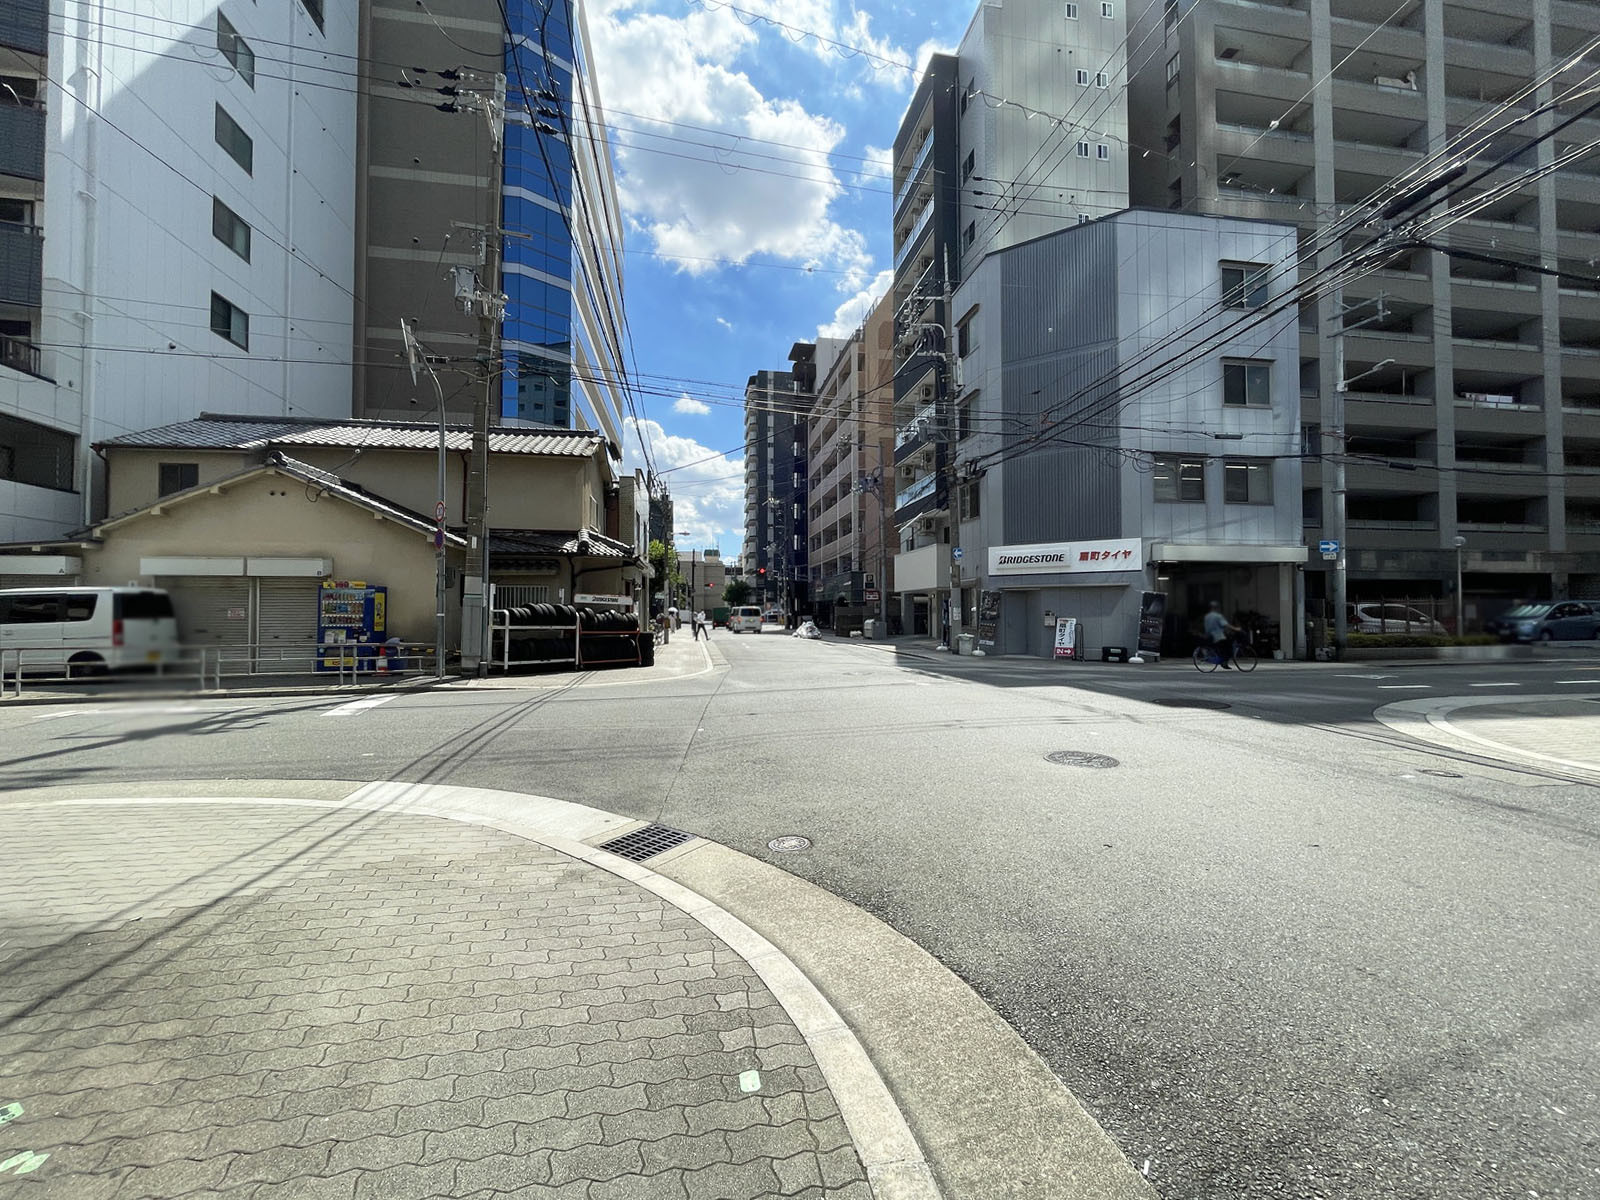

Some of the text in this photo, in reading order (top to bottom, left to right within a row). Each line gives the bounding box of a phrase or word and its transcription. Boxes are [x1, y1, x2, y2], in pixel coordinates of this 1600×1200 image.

[999, 554, 1064, 564] BRIDGESTONE
[1079, 550, 1132, 561] 扇町タイヤ
